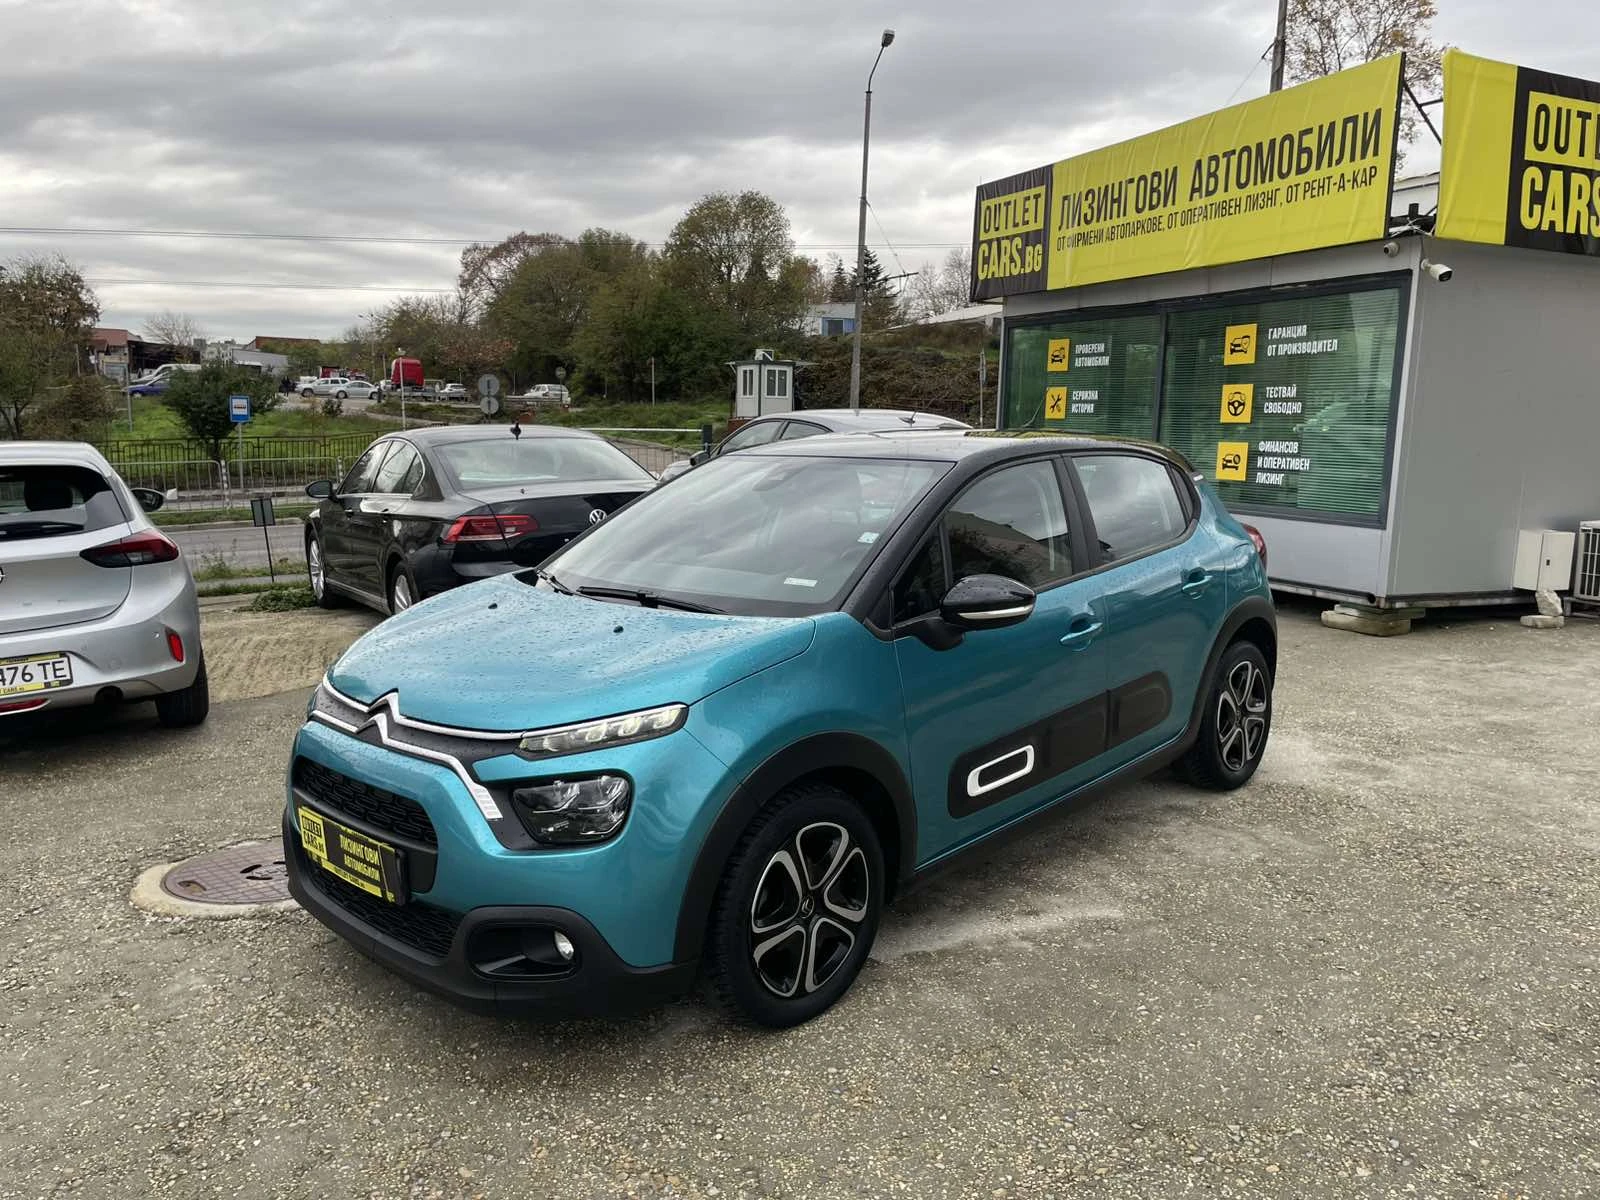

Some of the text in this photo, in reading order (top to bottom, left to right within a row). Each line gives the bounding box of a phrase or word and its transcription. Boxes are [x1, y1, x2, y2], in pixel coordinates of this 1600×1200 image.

[1533, 103, 1600, 161] OUT
[1058, 107, 1382, 232] ЛИЗИНГОВИ АВТОМОБИЛИ
[1167, 212, 1179, 230] ОТ
[1180, 196, 1242, 227] ОПЕРАТИВЕН
[1286, 182, 1301, 203] ОТ
[1303, 165, 1378, 200] РЕНТ-А-КАР
[983, 193, 1042, 234] OUTLET
[1268, 325, 1307, 340] ГАРАНЦИЯ
[1267, 338, 1338, 357] ОТ ПРОИЗВОДИТЕЛ
[1265, 384, 1297, 398] ТЕСТВАЙ
[1264, 402, 1302, 414] СВОБОДНО
[1258, 440, 1298, 454] ФИНАНСОВ
[1263, 457, 1310, 471] ОПЕРАТИВЕН
[1256, 472, 1285, 486] ЛИЗИНГ
[38, 660, 67, 680] TE
